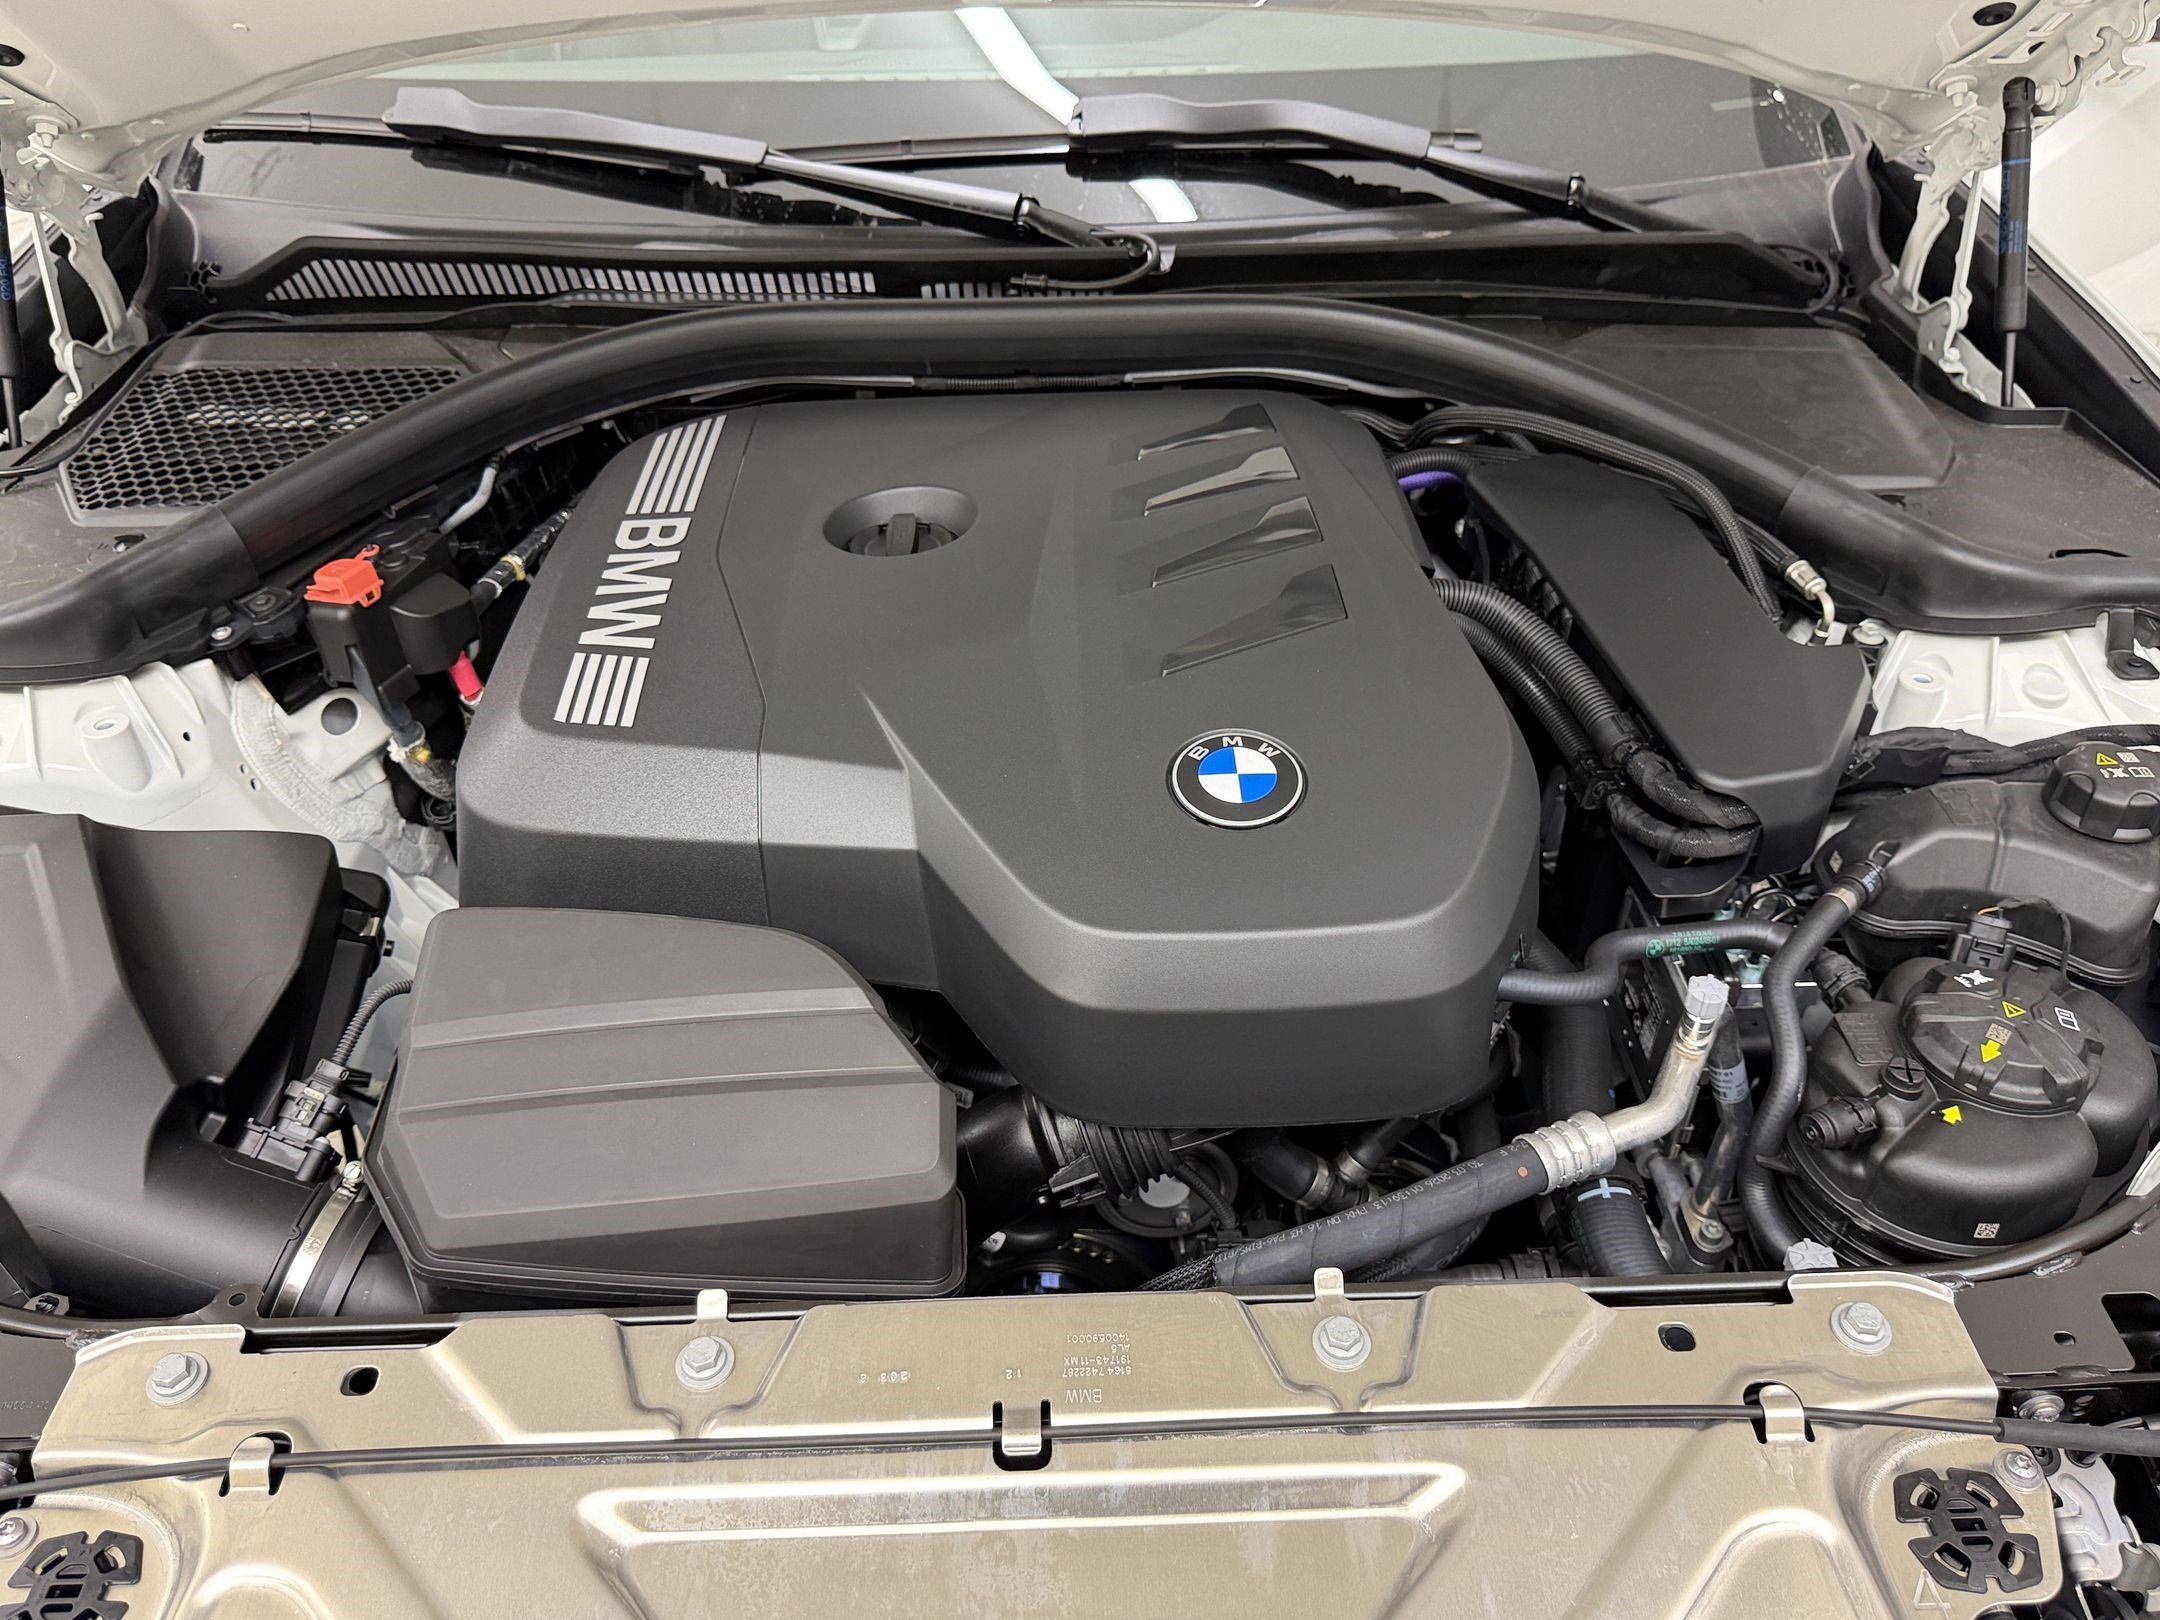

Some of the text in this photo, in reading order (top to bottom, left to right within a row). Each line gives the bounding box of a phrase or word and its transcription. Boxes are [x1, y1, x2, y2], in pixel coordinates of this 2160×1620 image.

[578, 517, 691, 649] BMW
[1187, 736, 1281, 760] BMW
[1062, 1366, 1132, 1378] 5164 7422287
[1064, 1388, 1103, 1404] BMW
